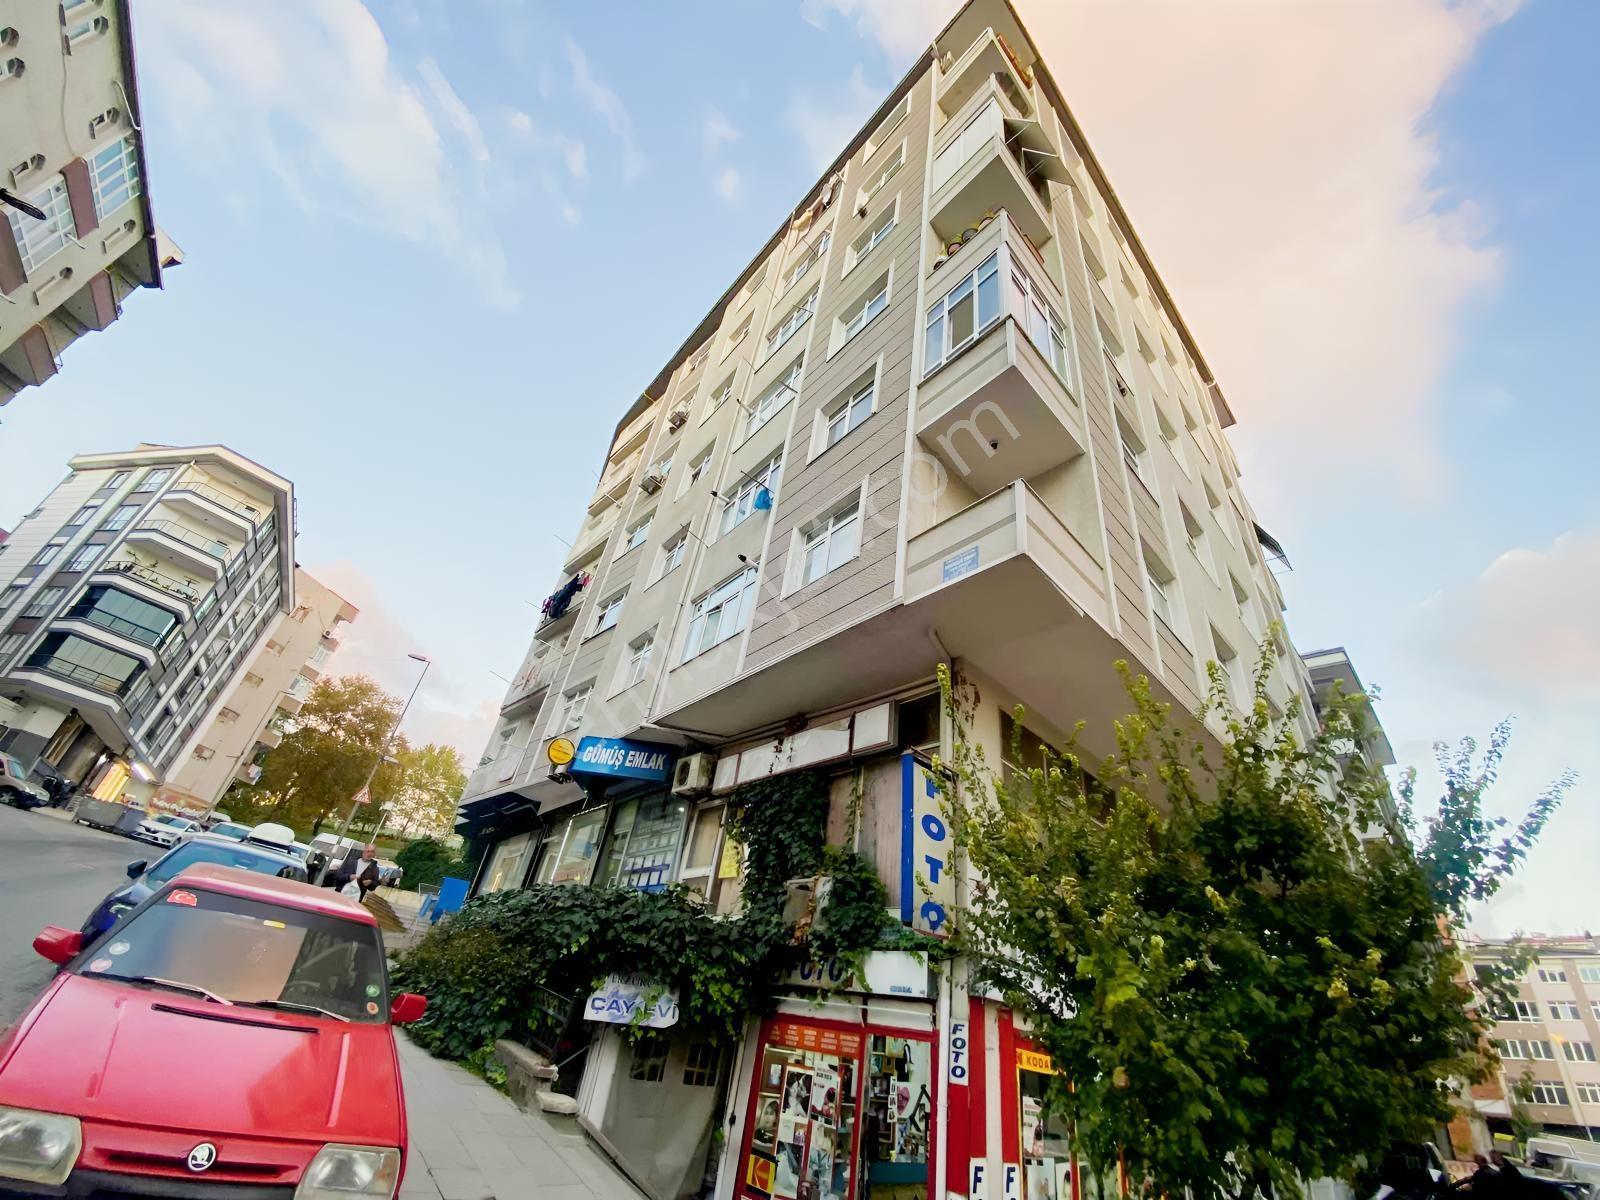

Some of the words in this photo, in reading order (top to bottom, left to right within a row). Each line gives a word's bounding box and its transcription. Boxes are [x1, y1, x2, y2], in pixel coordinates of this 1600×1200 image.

[583, 744, 625, 769] GÜMÜŞ
[625, 751, 667, 770] EMLAK
[590, 996, 636, 1015] ÇAY
[951, 1023, 967, 1079] FOTO
